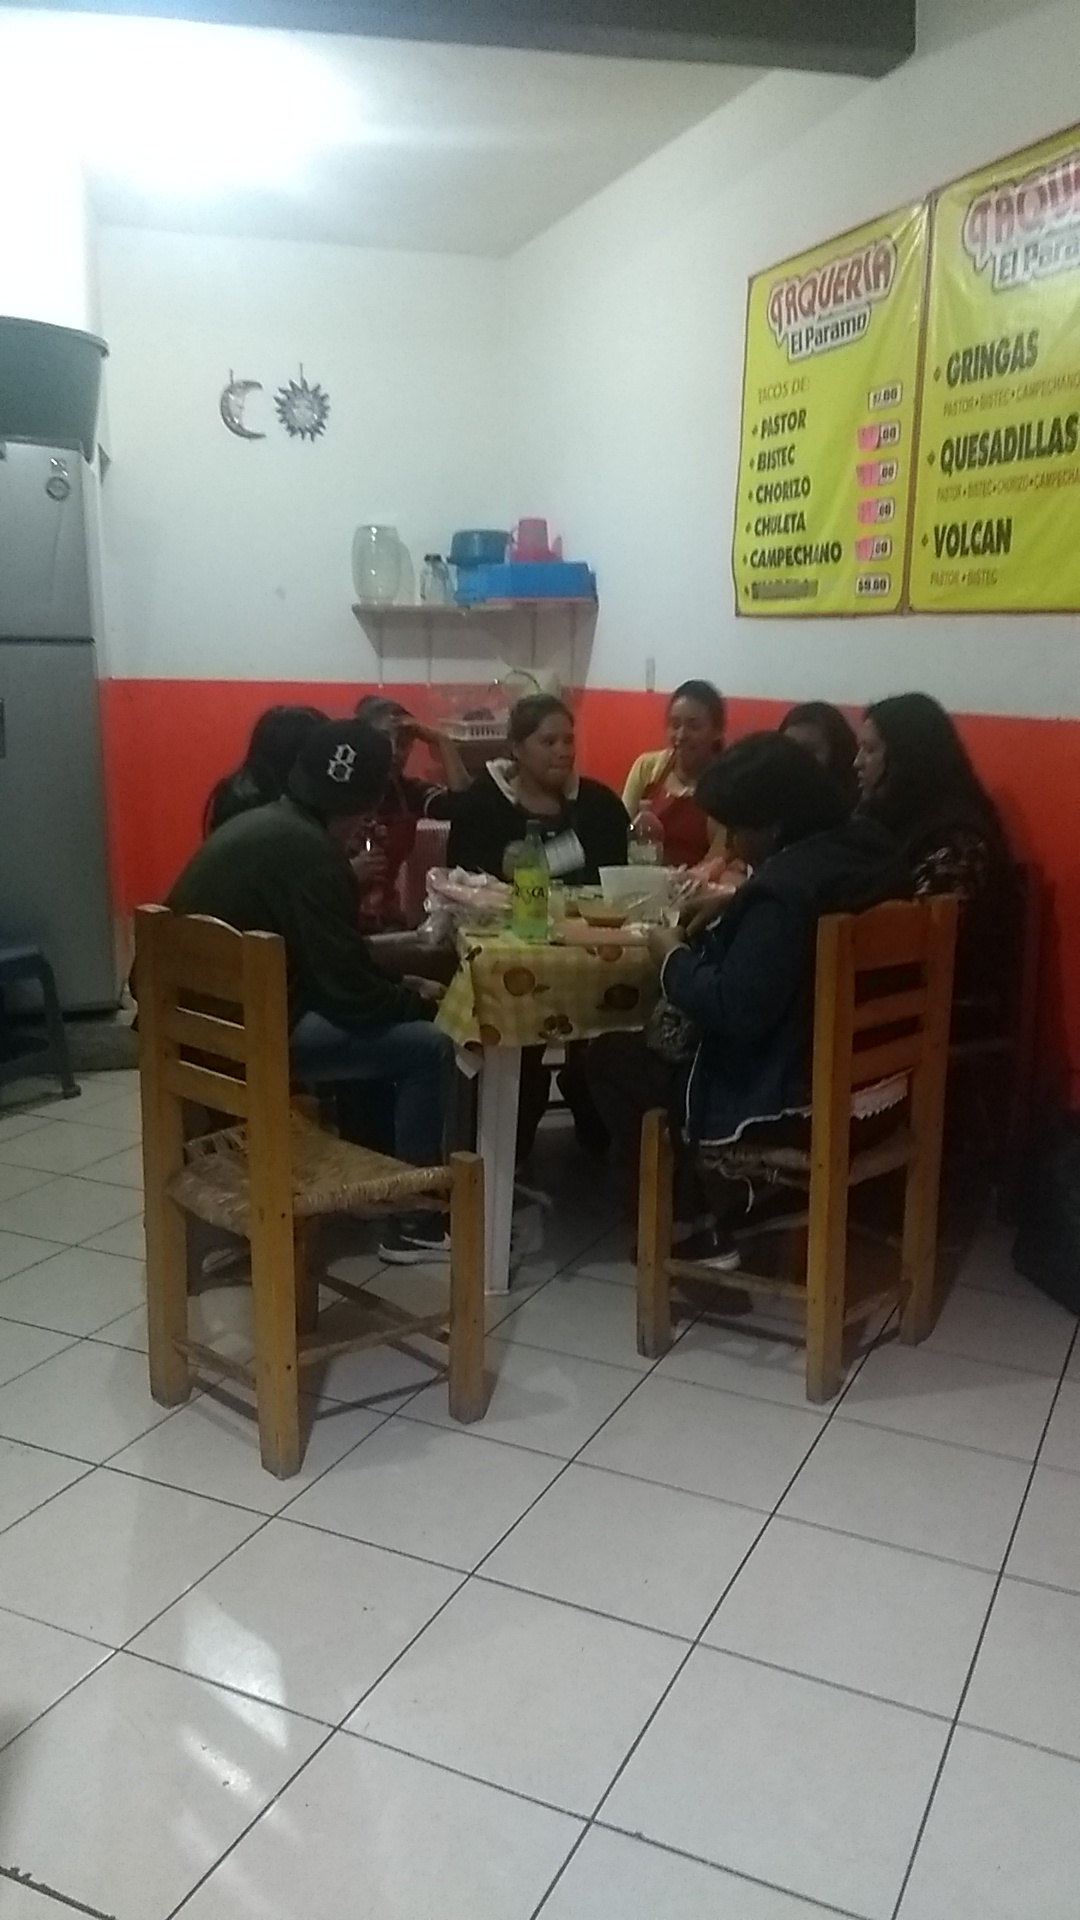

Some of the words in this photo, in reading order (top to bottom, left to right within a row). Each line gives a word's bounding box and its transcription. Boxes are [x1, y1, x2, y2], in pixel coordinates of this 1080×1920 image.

[969, 162, 1080, 259] TAQU
[791, 331, 802, 355] El
[806, 313, 867, 350] Paramo
[946, 328, 1039, 388] GRINGAS
[761, 408, 807, 439] PASTOR
[757, 444, 796, 472] BISTEC
[940, 412, 1080, 477] QUESADILLAS
[755, 475, 812, 504] CHORIZO
[754, 511, 807, 538] CHULETA
[933, 517, 1013, 559] VOLCAN
[750, 541, 843, 569] CAMPECHANO
